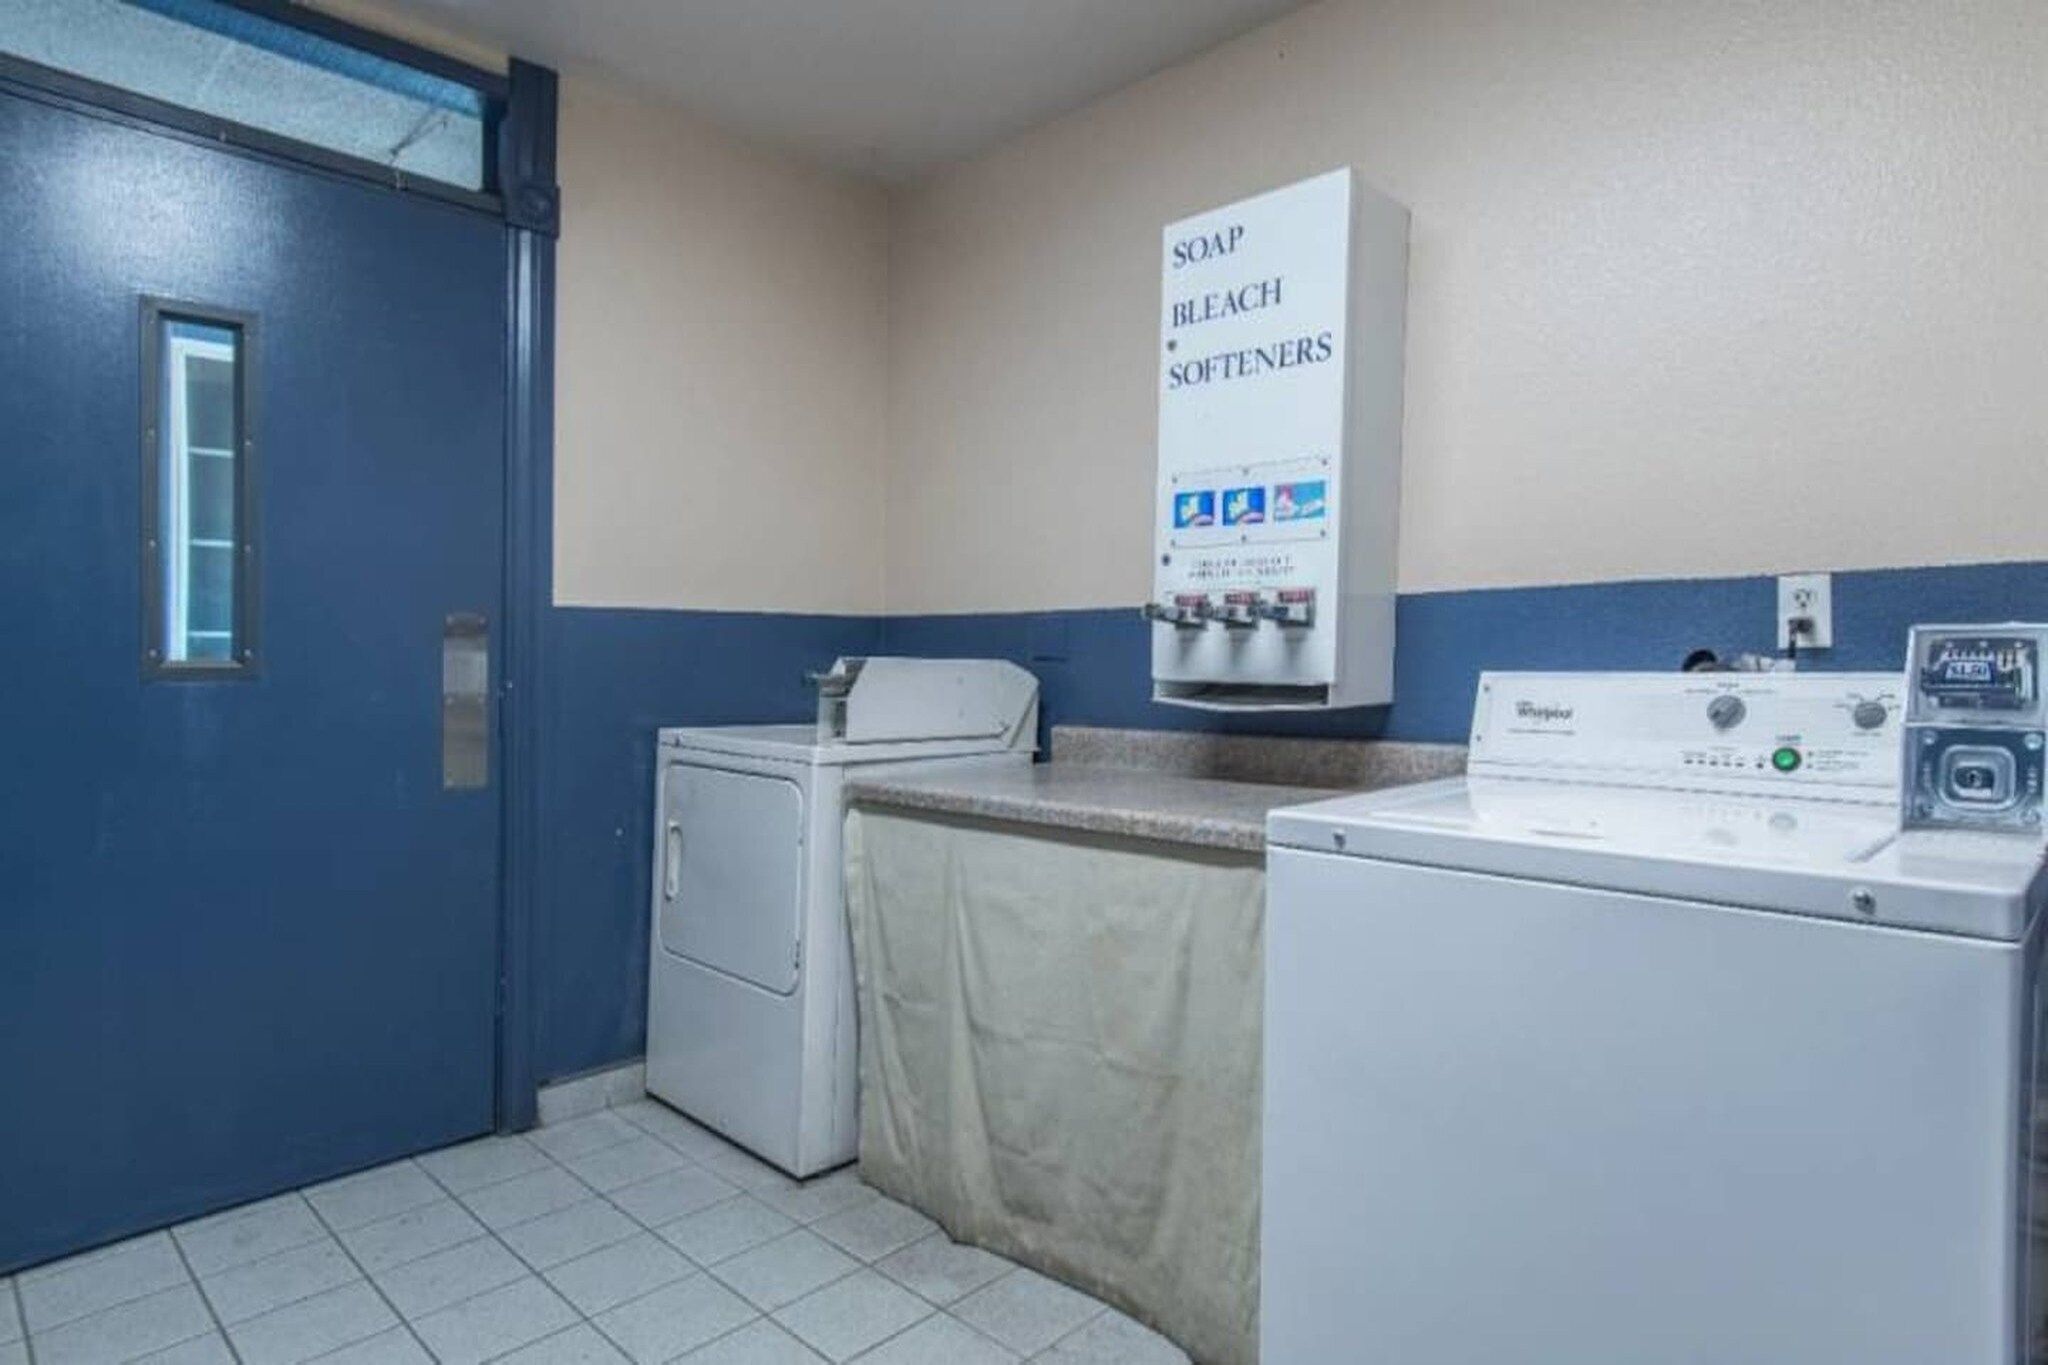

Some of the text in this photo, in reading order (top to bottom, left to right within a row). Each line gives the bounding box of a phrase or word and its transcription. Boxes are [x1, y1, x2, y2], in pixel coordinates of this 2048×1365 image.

[1173, 224, 1244, 269] SOAP
[1172, 277, 1283, 328] BLEACH
[1169, 331, 1333, 390] SOFTENERS
